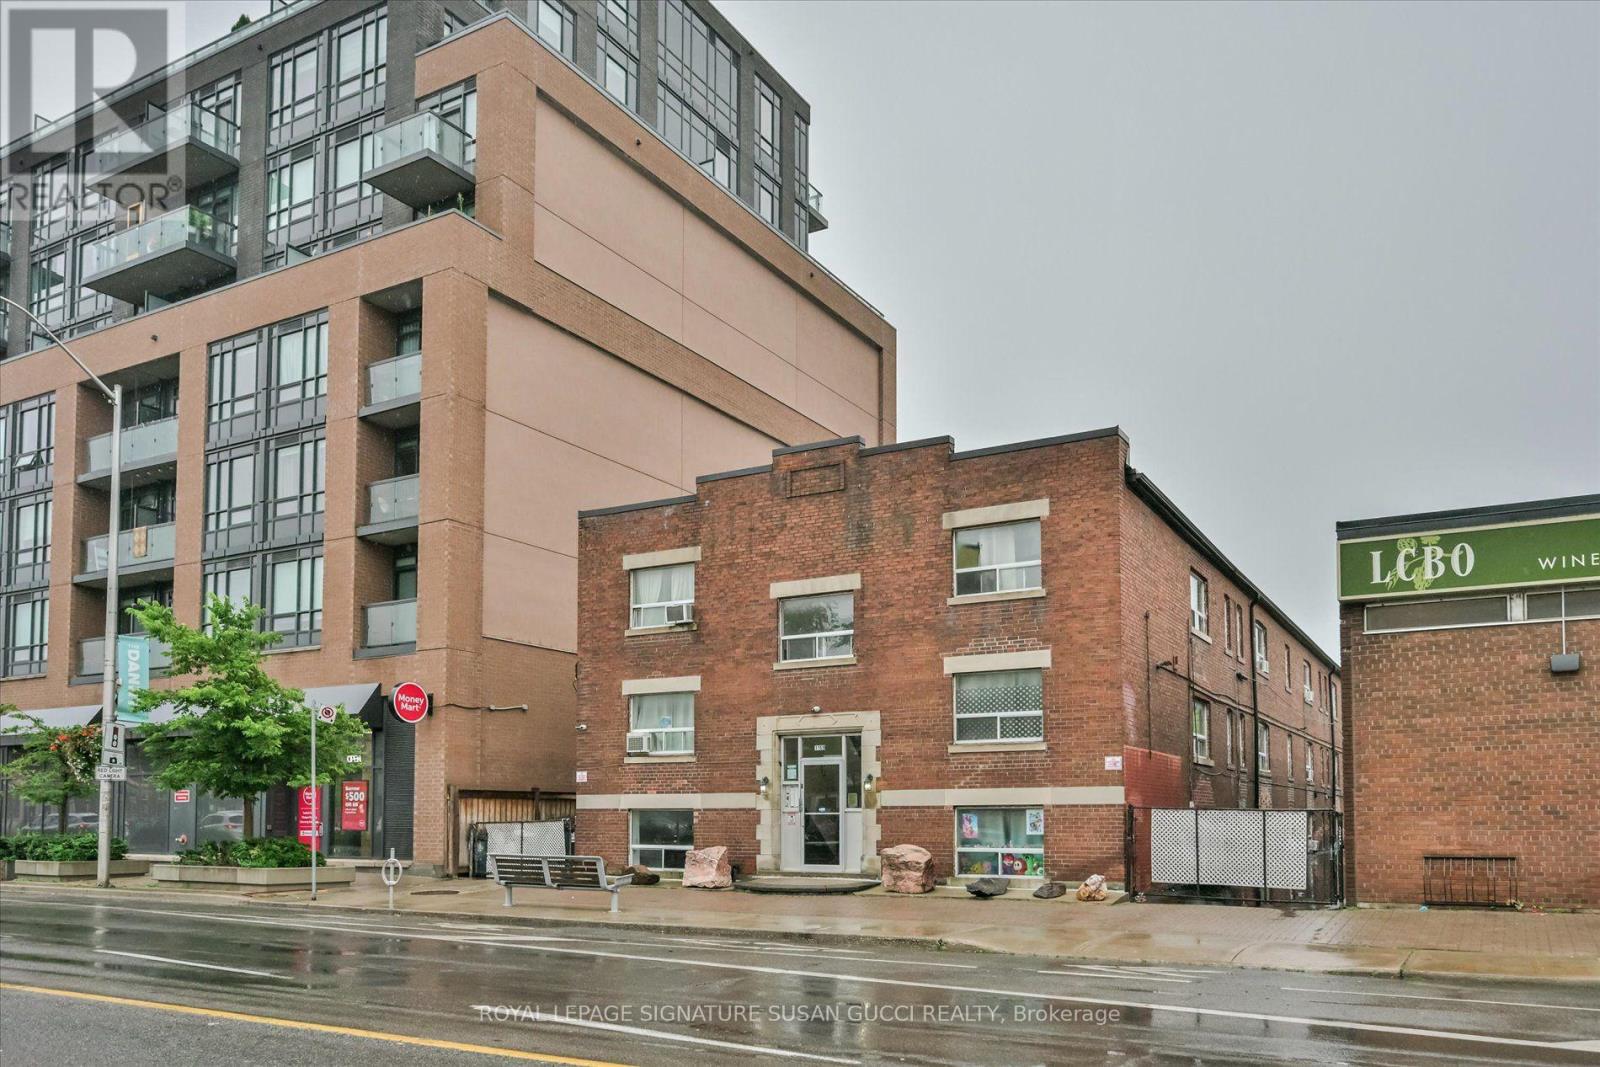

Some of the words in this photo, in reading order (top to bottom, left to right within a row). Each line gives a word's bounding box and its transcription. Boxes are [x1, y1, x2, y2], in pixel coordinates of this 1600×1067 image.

[1369, 542, 1475, 584] LCBO
[1537, 552, 1600, 570] WINE
[398, 693, 425, 706] Money
[400, 702, 421, 712] Mart
[346, 754, 362, 763] OPEN
[345, 791, 365, 802] $500
